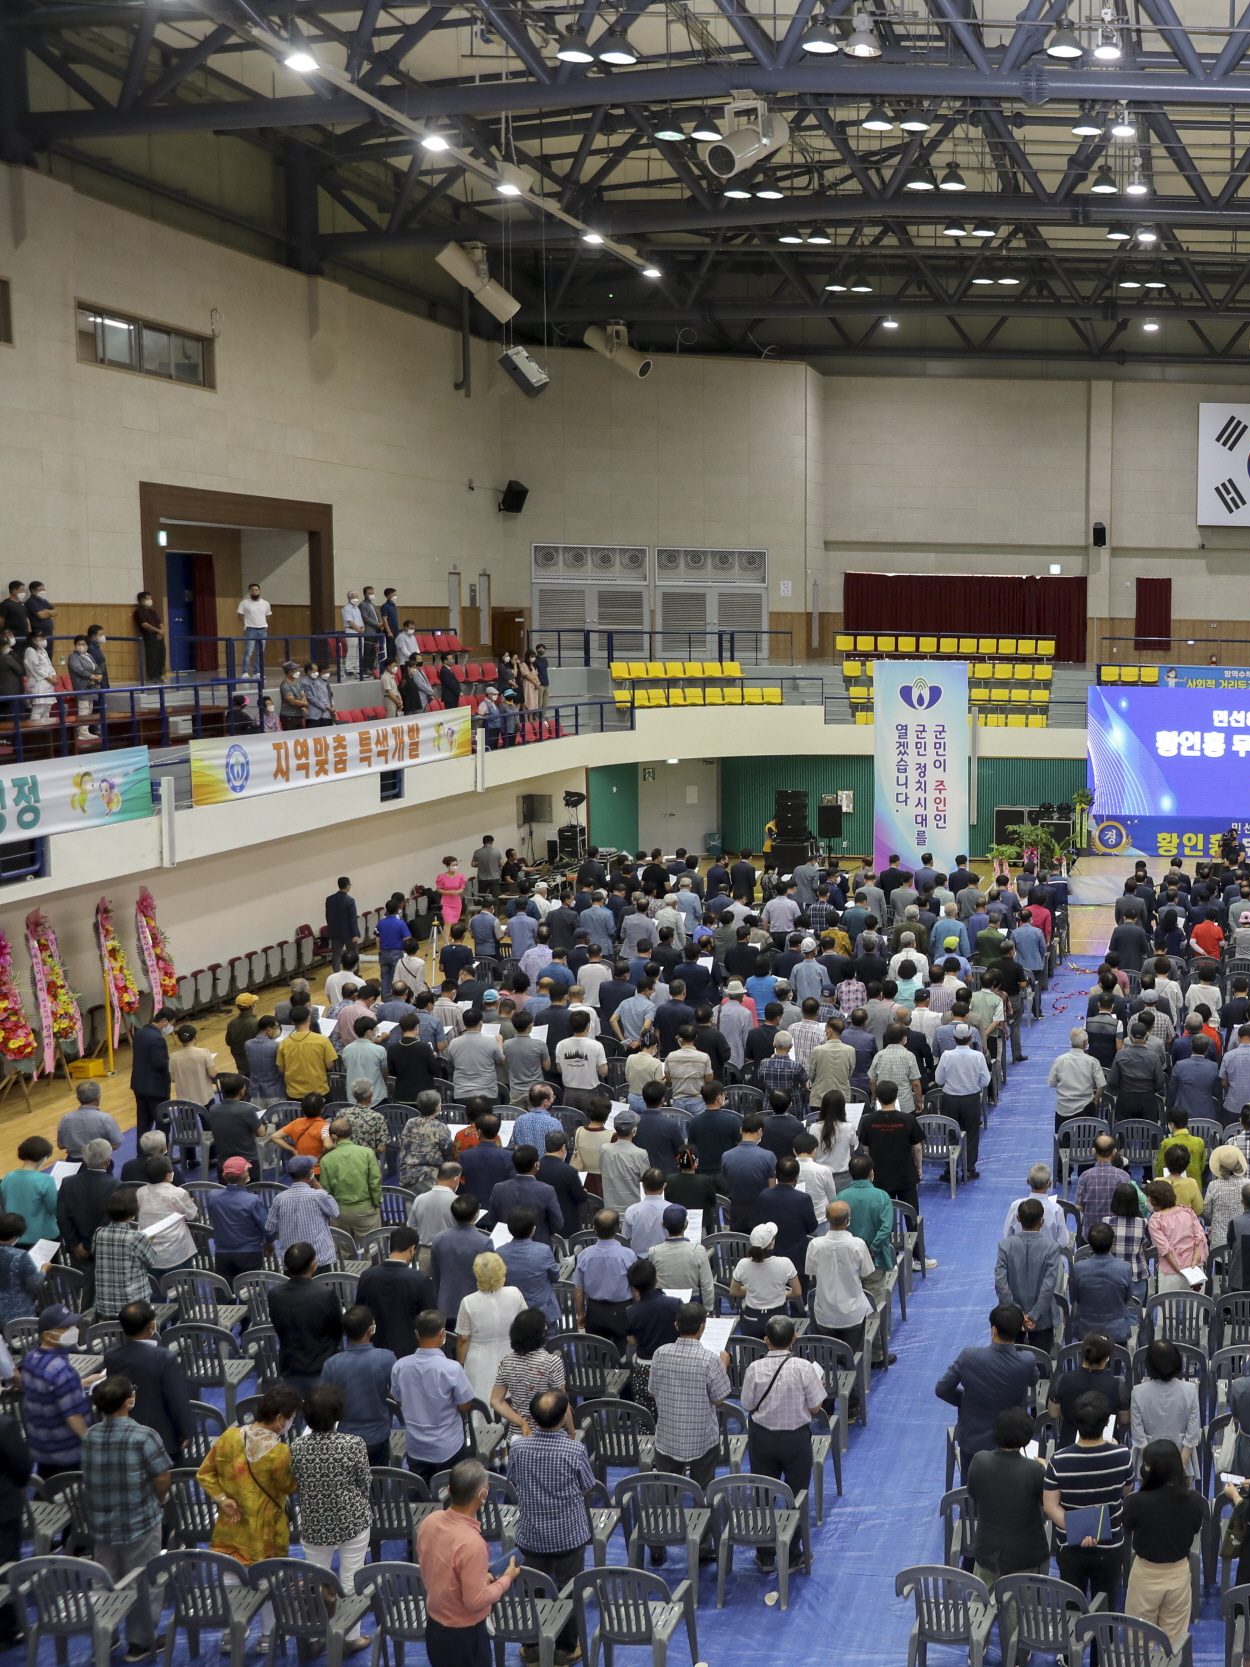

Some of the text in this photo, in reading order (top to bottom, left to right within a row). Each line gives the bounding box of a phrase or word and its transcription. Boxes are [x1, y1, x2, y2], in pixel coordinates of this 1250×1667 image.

[272, 722, 421, 783] 지역맞춤 특색개발
[895, 723, 910, 813] 열겠습니다.
[914, 724, 928, 846] 군민 정치시대를
[933, 724, 947, 829] 군민이 주인인
[0, 774, 41, 836] 정
[1103, 829, 1117, 845] 경
